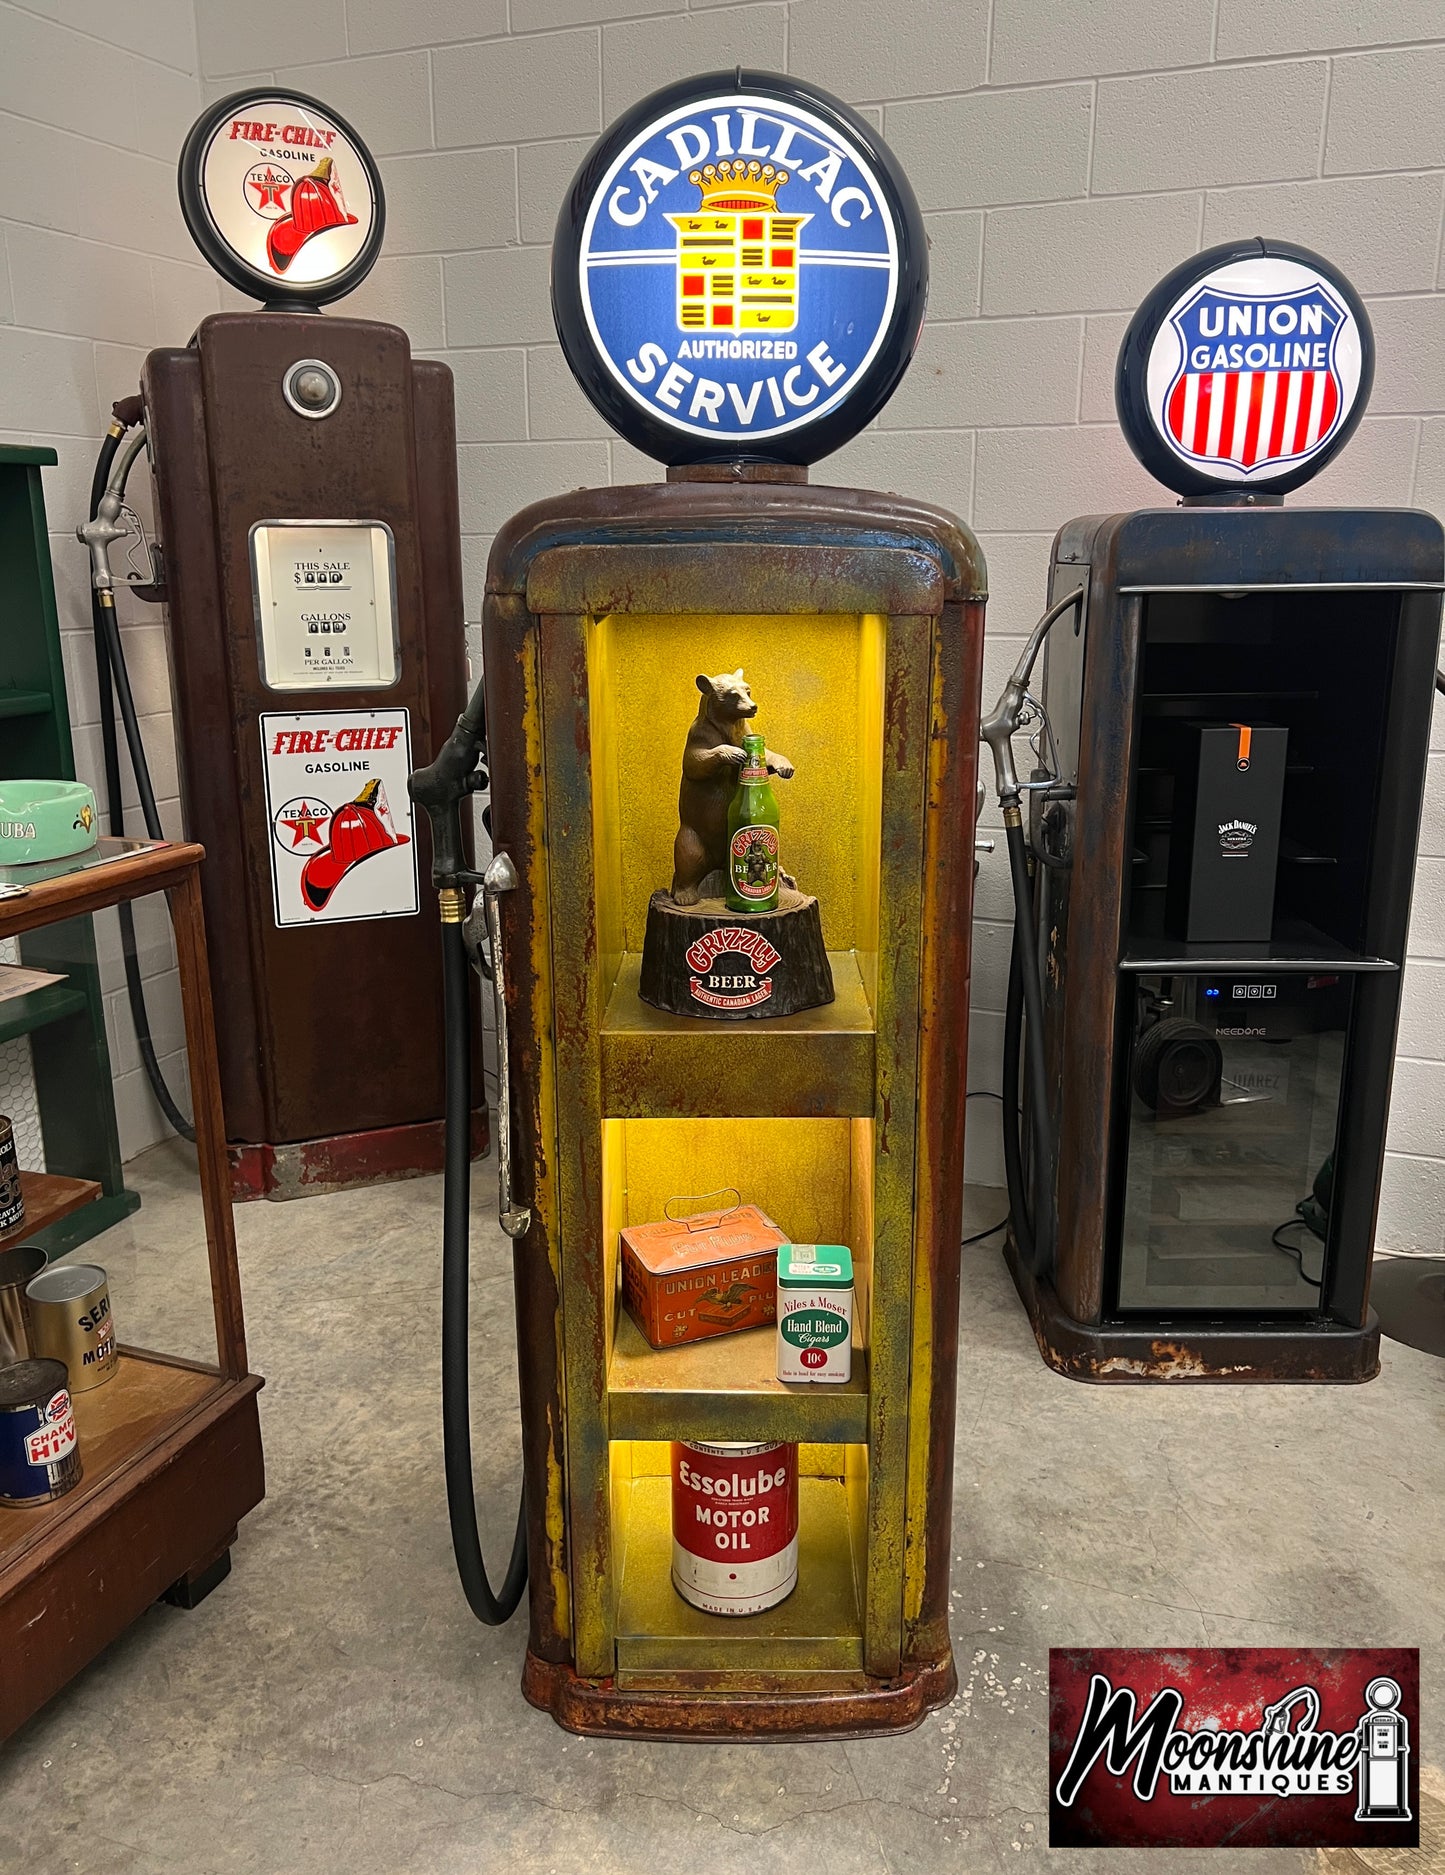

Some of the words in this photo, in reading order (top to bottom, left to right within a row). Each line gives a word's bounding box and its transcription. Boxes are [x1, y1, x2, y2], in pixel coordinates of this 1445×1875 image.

[229, 121, 337, 150] FIRE-CHIEF
[260, 148, 316, 162] GASOLINE
[251, 173, 291, 184] TEXACO
[608, 112, 873, 228] CADILLAC
[1199, 304, 1323, 338] UNION
[677, 340, 798, 360] AUTHORIZED
[1191, 342, 1327, 369] GASOLINE
[626, 340, 847, 425] SERVICE
[294, 562, 320, 571] THIS
[323, 562, 351, 571] SALE
[300, 613, 351, 622] GALLONS
[272, 727, 403, 755] FIRE-CHIEF
[305, 760, 370, 774] GASOLINE
[282, 807, 328, 819] TEXACO
[686, 927, 782, 975] GRIZZLY
[709, 975, 757, 989] BEER
[694, 988, 721, 1006] AUTHENTIC
[722, 997, 751, 1007] CANADIAN
[751, 988, 769, 1002] LAGER
[666, 1274, 716, 1296] UNION
[722, 1259, 777, 1284] LEADE
[664, 1308, 697, 1323] CUT
[749, 1290, 778, 1304] PLU
[784, 1299, 807, 1315] Niles
[809, 1299, 816, 1308] &
[818, 1296, 848, 1316] Moser
[787, 1319, 812, 1333] Hand
[815, 1319, 842, 1334] Blend
[798, 1332, 830, 1347] Cigars
[807, 1352, 822, 1364] 10¢
[30, 1415, 74, 1447] CHAMP
[680, 1460, 786, 1498] Essolube
[696, 1504, 770, 1528] MOTOR
[715, 1532, 751, 1549] OIL
[702, 1603, 722, 1612] MADE
